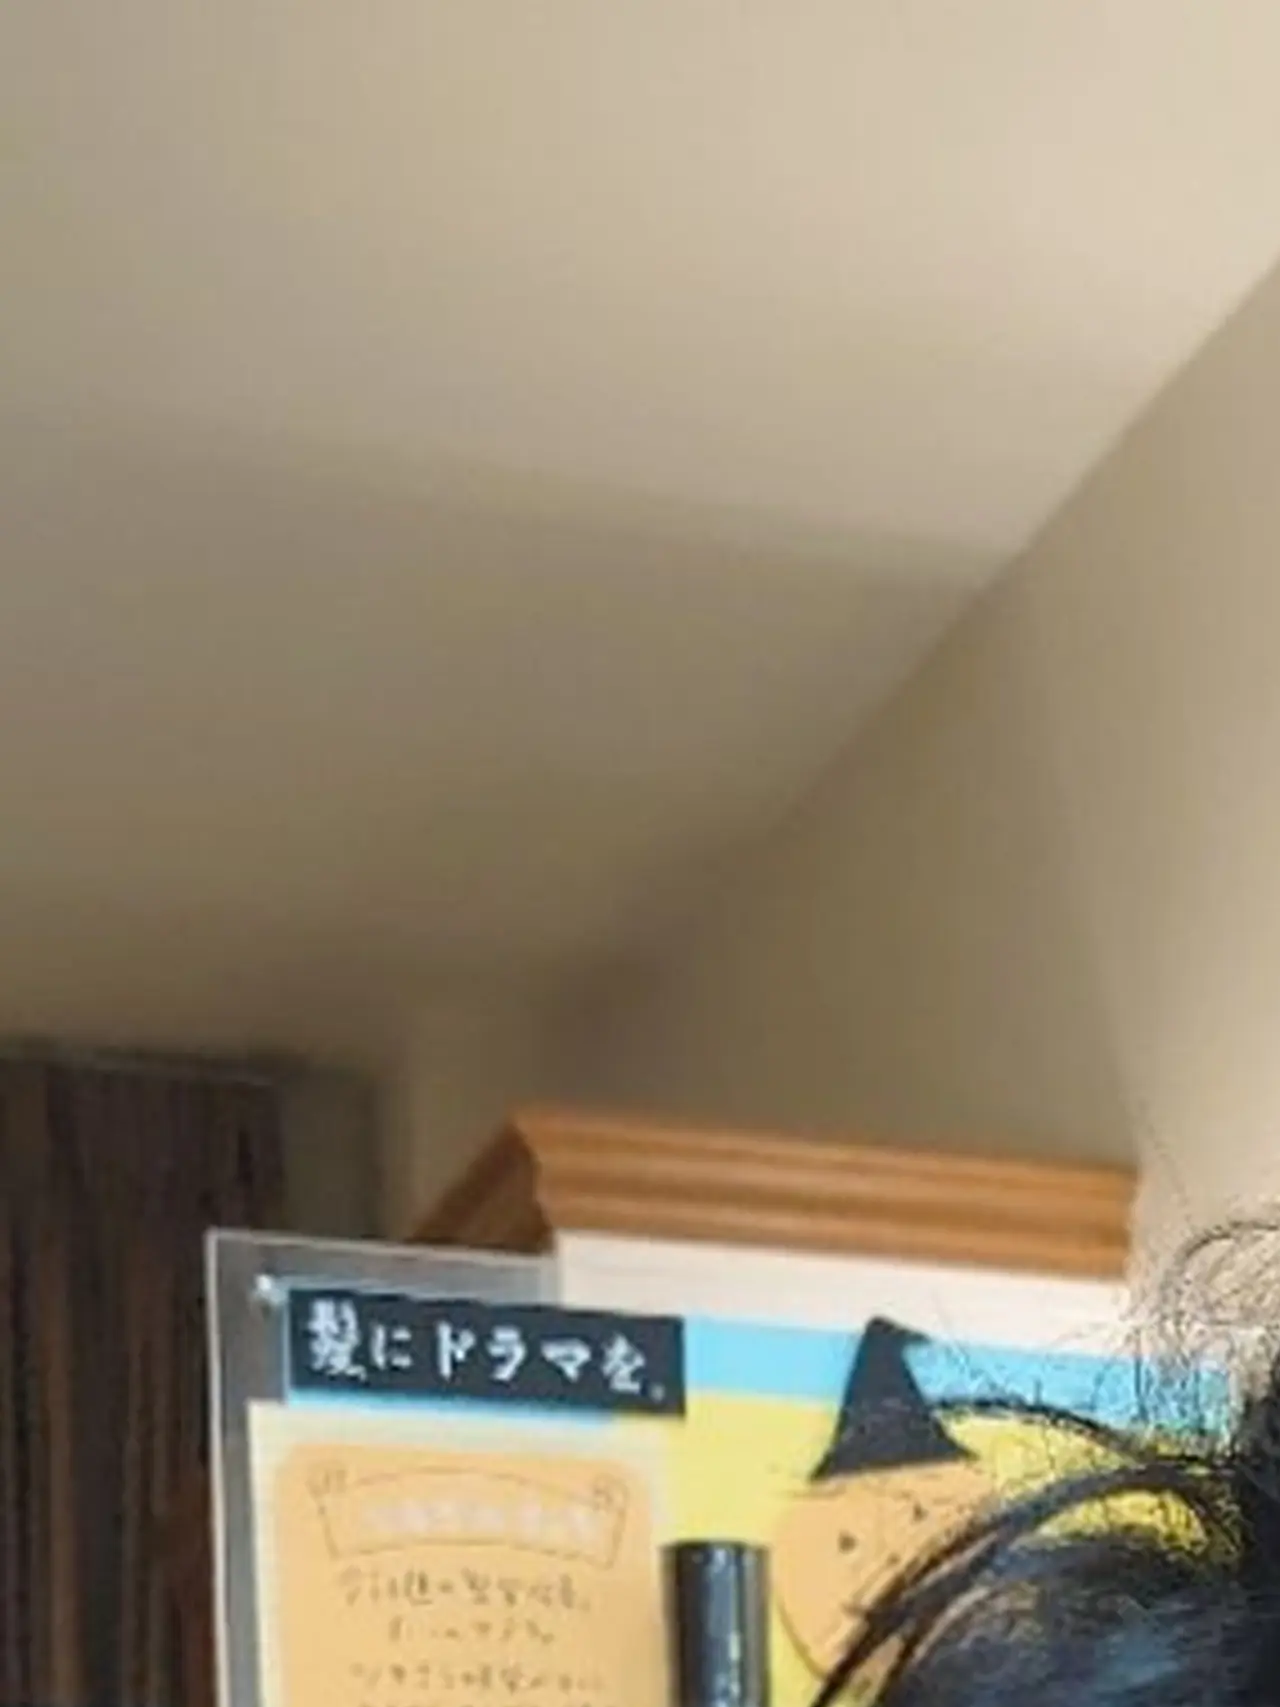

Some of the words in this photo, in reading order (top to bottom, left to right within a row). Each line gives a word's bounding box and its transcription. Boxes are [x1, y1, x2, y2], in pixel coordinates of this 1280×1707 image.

[308, 1297, 666, 1403] 髪にドラマを。
